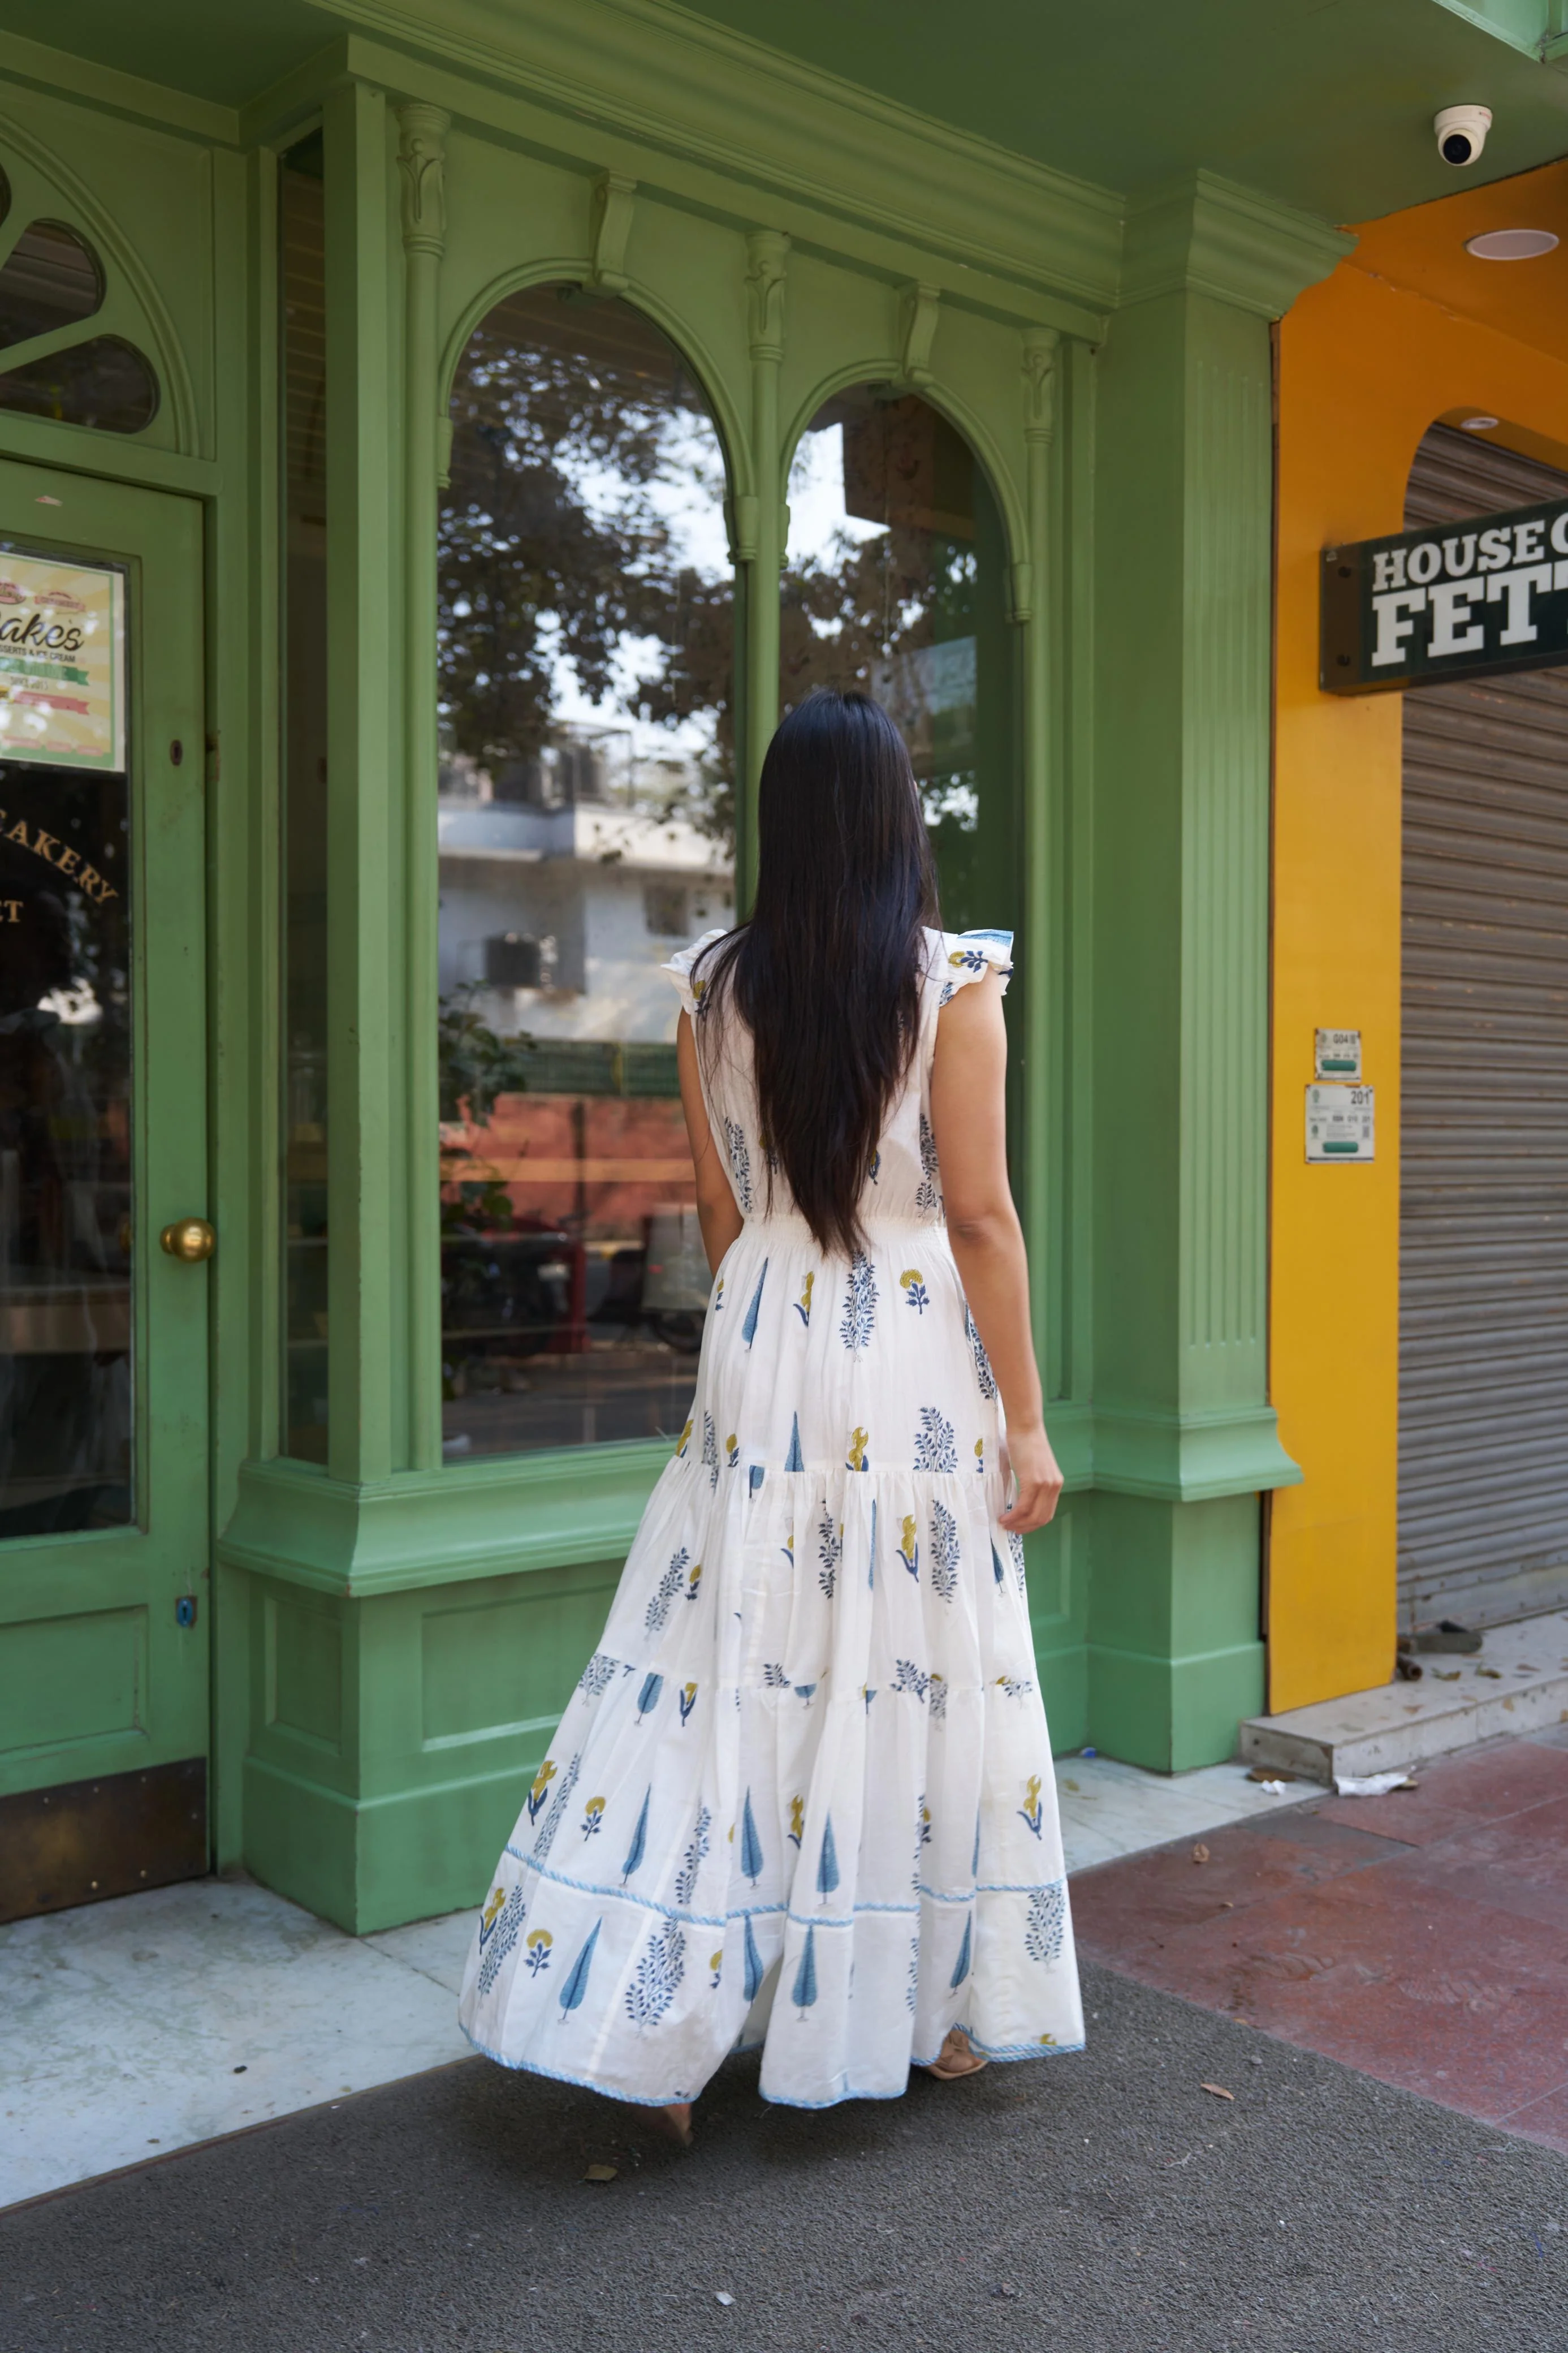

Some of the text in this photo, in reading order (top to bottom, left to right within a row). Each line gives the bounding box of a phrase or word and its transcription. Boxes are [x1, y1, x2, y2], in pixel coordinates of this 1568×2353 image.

[1372, 519, 1545, 592] HOUSE
[1371, 560, 1568, 667] FET
[1351, 1090, 1369, 1105] 201
